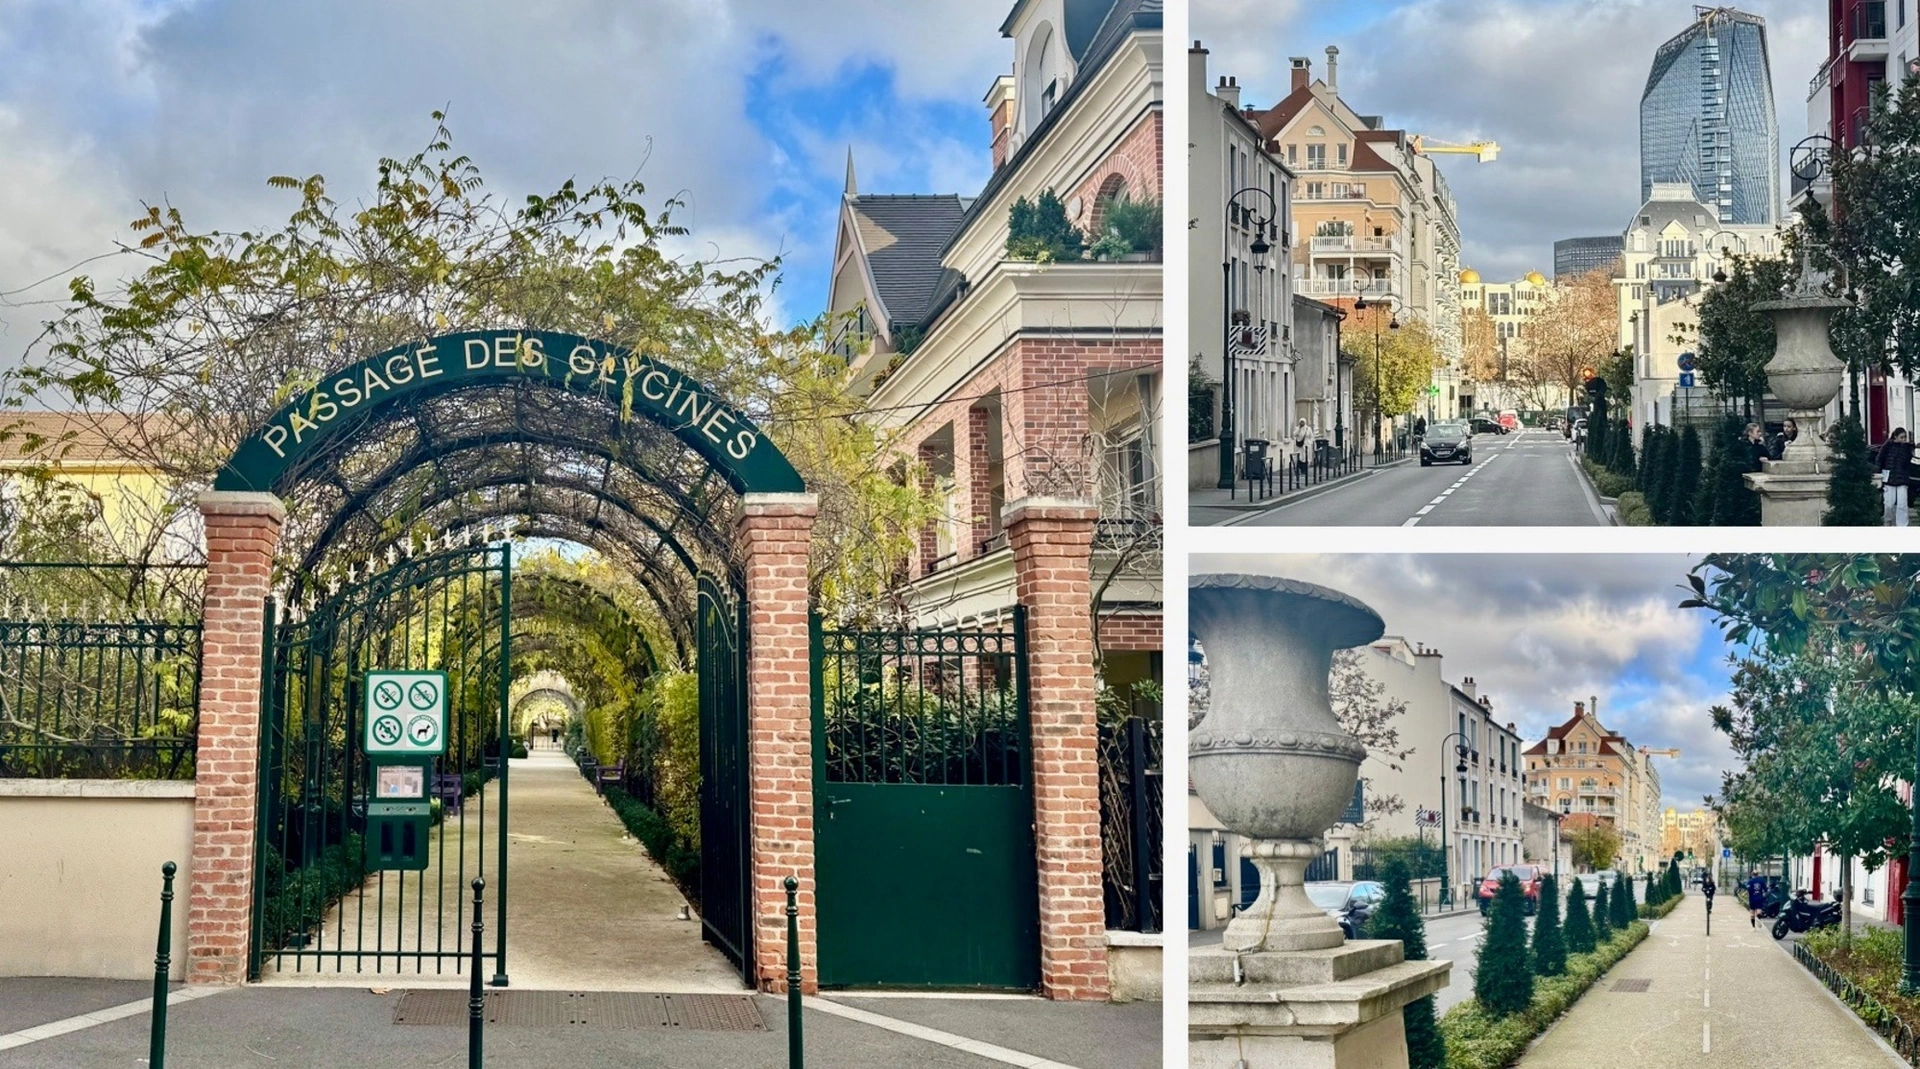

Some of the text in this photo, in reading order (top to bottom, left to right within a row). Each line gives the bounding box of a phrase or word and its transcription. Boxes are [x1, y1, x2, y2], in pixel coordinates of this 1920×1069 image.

[263, 338, 756, 460] PASSAGE DES GLYCINES
